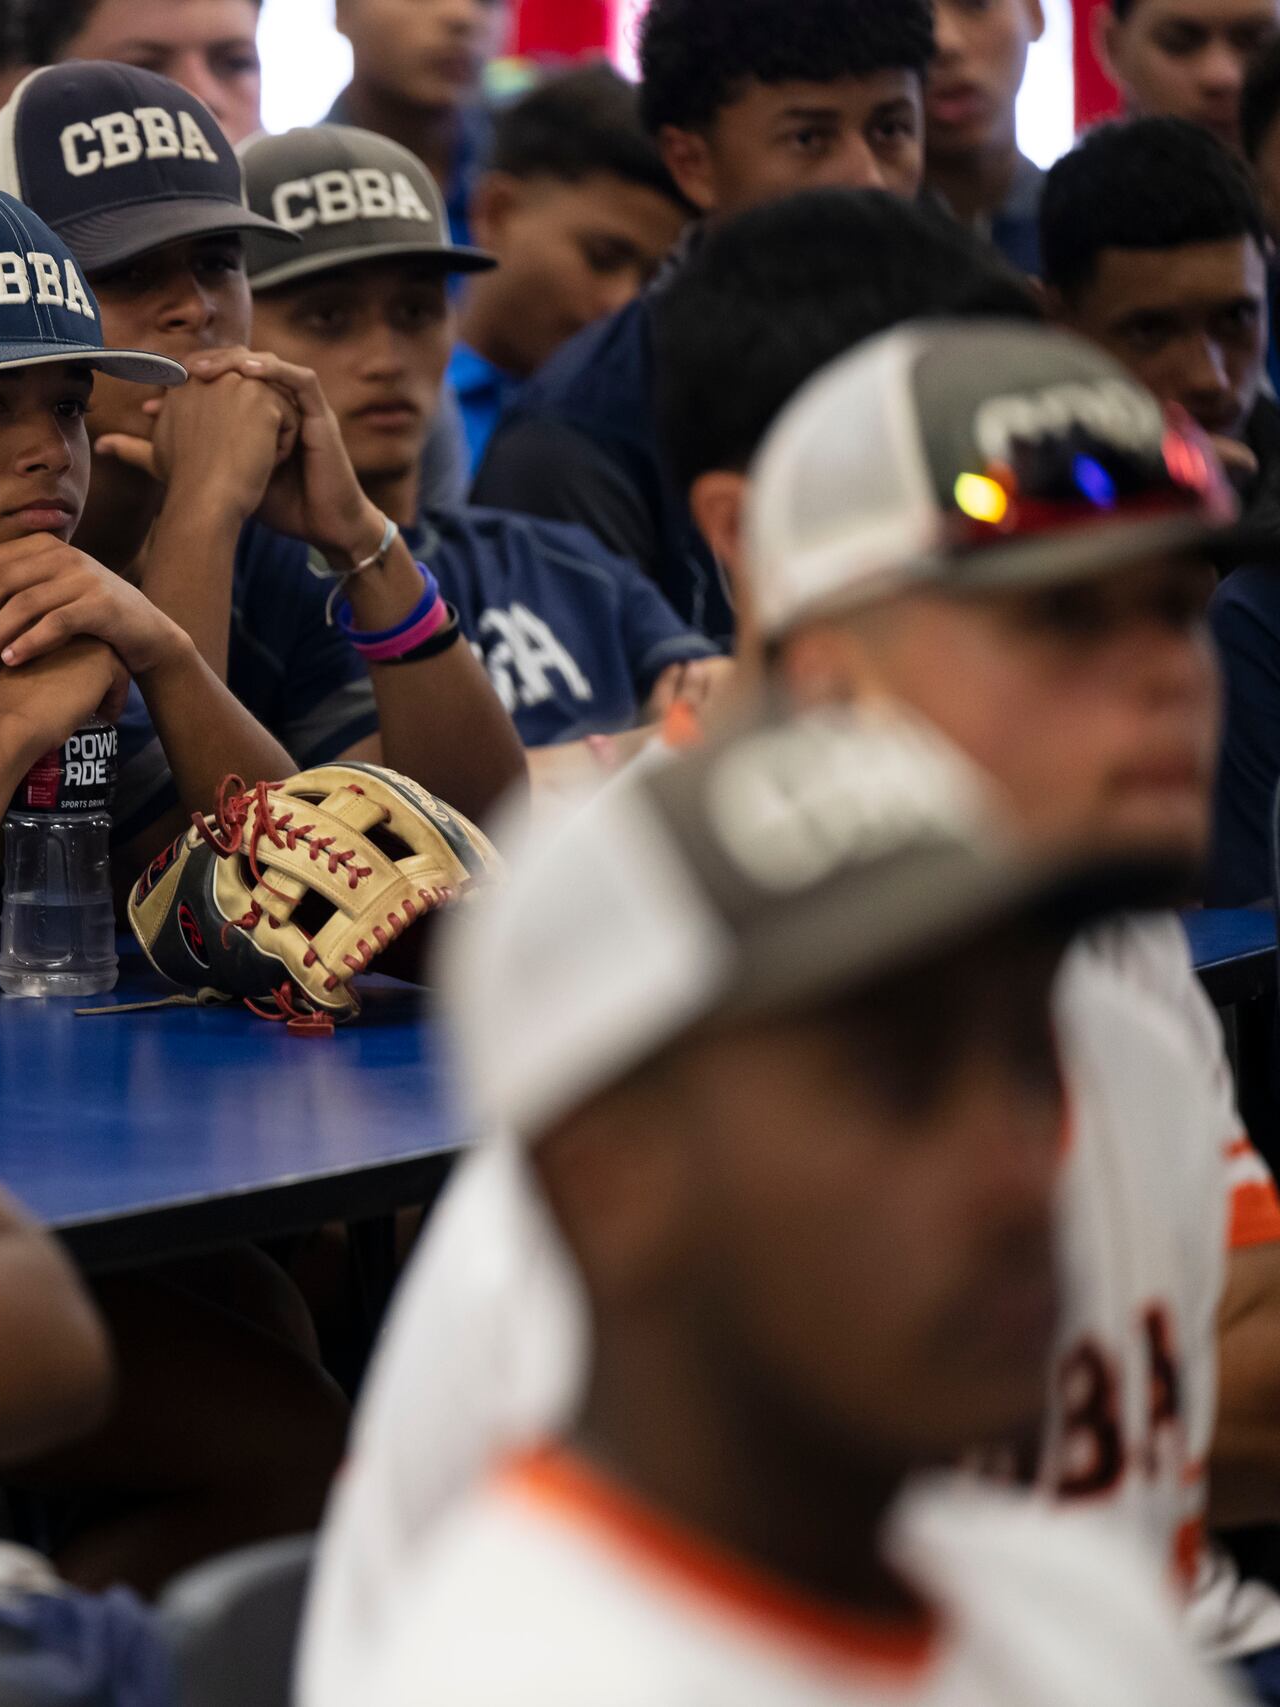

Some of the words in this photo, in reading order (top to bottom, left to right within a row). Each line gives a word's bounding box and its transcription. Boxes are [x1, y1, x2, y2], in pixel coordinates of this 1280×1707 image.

[59, 106, 219, 177] CBBA
[272, 168, 433, 232] CBBA
[64, 759, 107, 786] ADE
[60, 800, 87, 809] SPORTS
